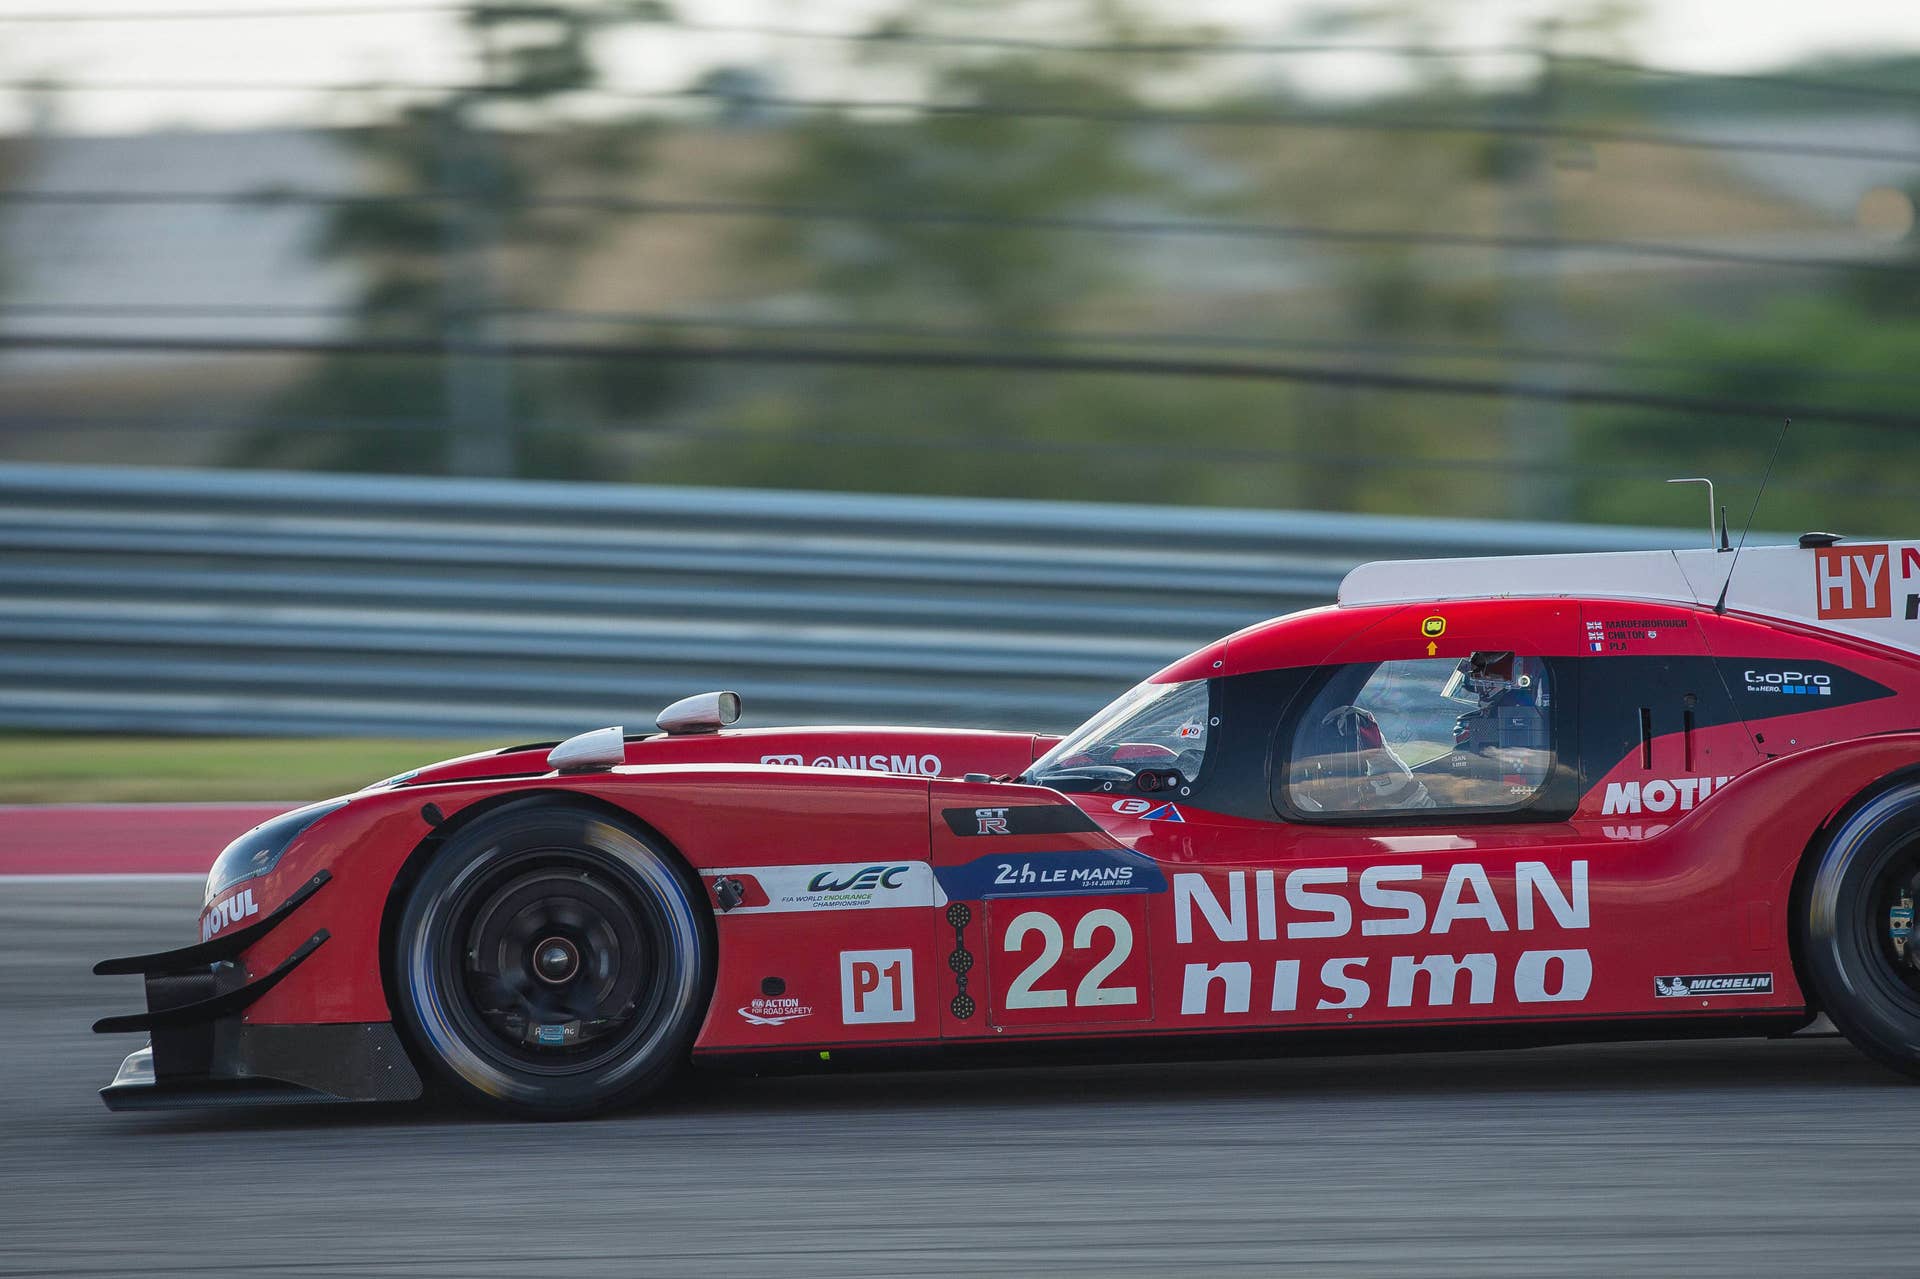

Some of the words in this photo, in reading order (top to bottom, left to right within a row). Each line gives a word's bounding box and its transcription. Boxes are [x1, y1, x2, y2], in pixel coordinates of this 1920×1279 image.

[1819, 554, 1885, 610] HY
[1606, 620, 1688, 629] MARDENBOROUGH
[1608, 631, 1645, 639] CHILTON
[1609, 642, 1627, 651] PLA
[1744, 670, 1831, 685] GoPro
[1601, 775, 1737, 815] MOT
[975, 808, 1009, 818] GT
[976, 817, 1011, 835] R
[807, 866, 910, 892] WEC
[1040, 870, 1067, 883] LE
[1070, 867, 1133, 881] MANS
[812, 899, 871, 908] CHAMPIONSHIP
[823, 893, 873, 901] ENDURANCE
[1173, 860, 1590, 943] NISSAN
[202, 888, 259, 943] MOTUL
[1004, 909, 1137, 1009] 22
[852, 961, 903, 1013] P1
[1180, 948, 1593, 1015] nismo
[1690, 977, 1770, 989] MICHELIN
[763, 1006, 784, 1014] ROAD
[785, 1006, 812, 1014] SAFETY
[765, 999, 798, 1007] ACTION
